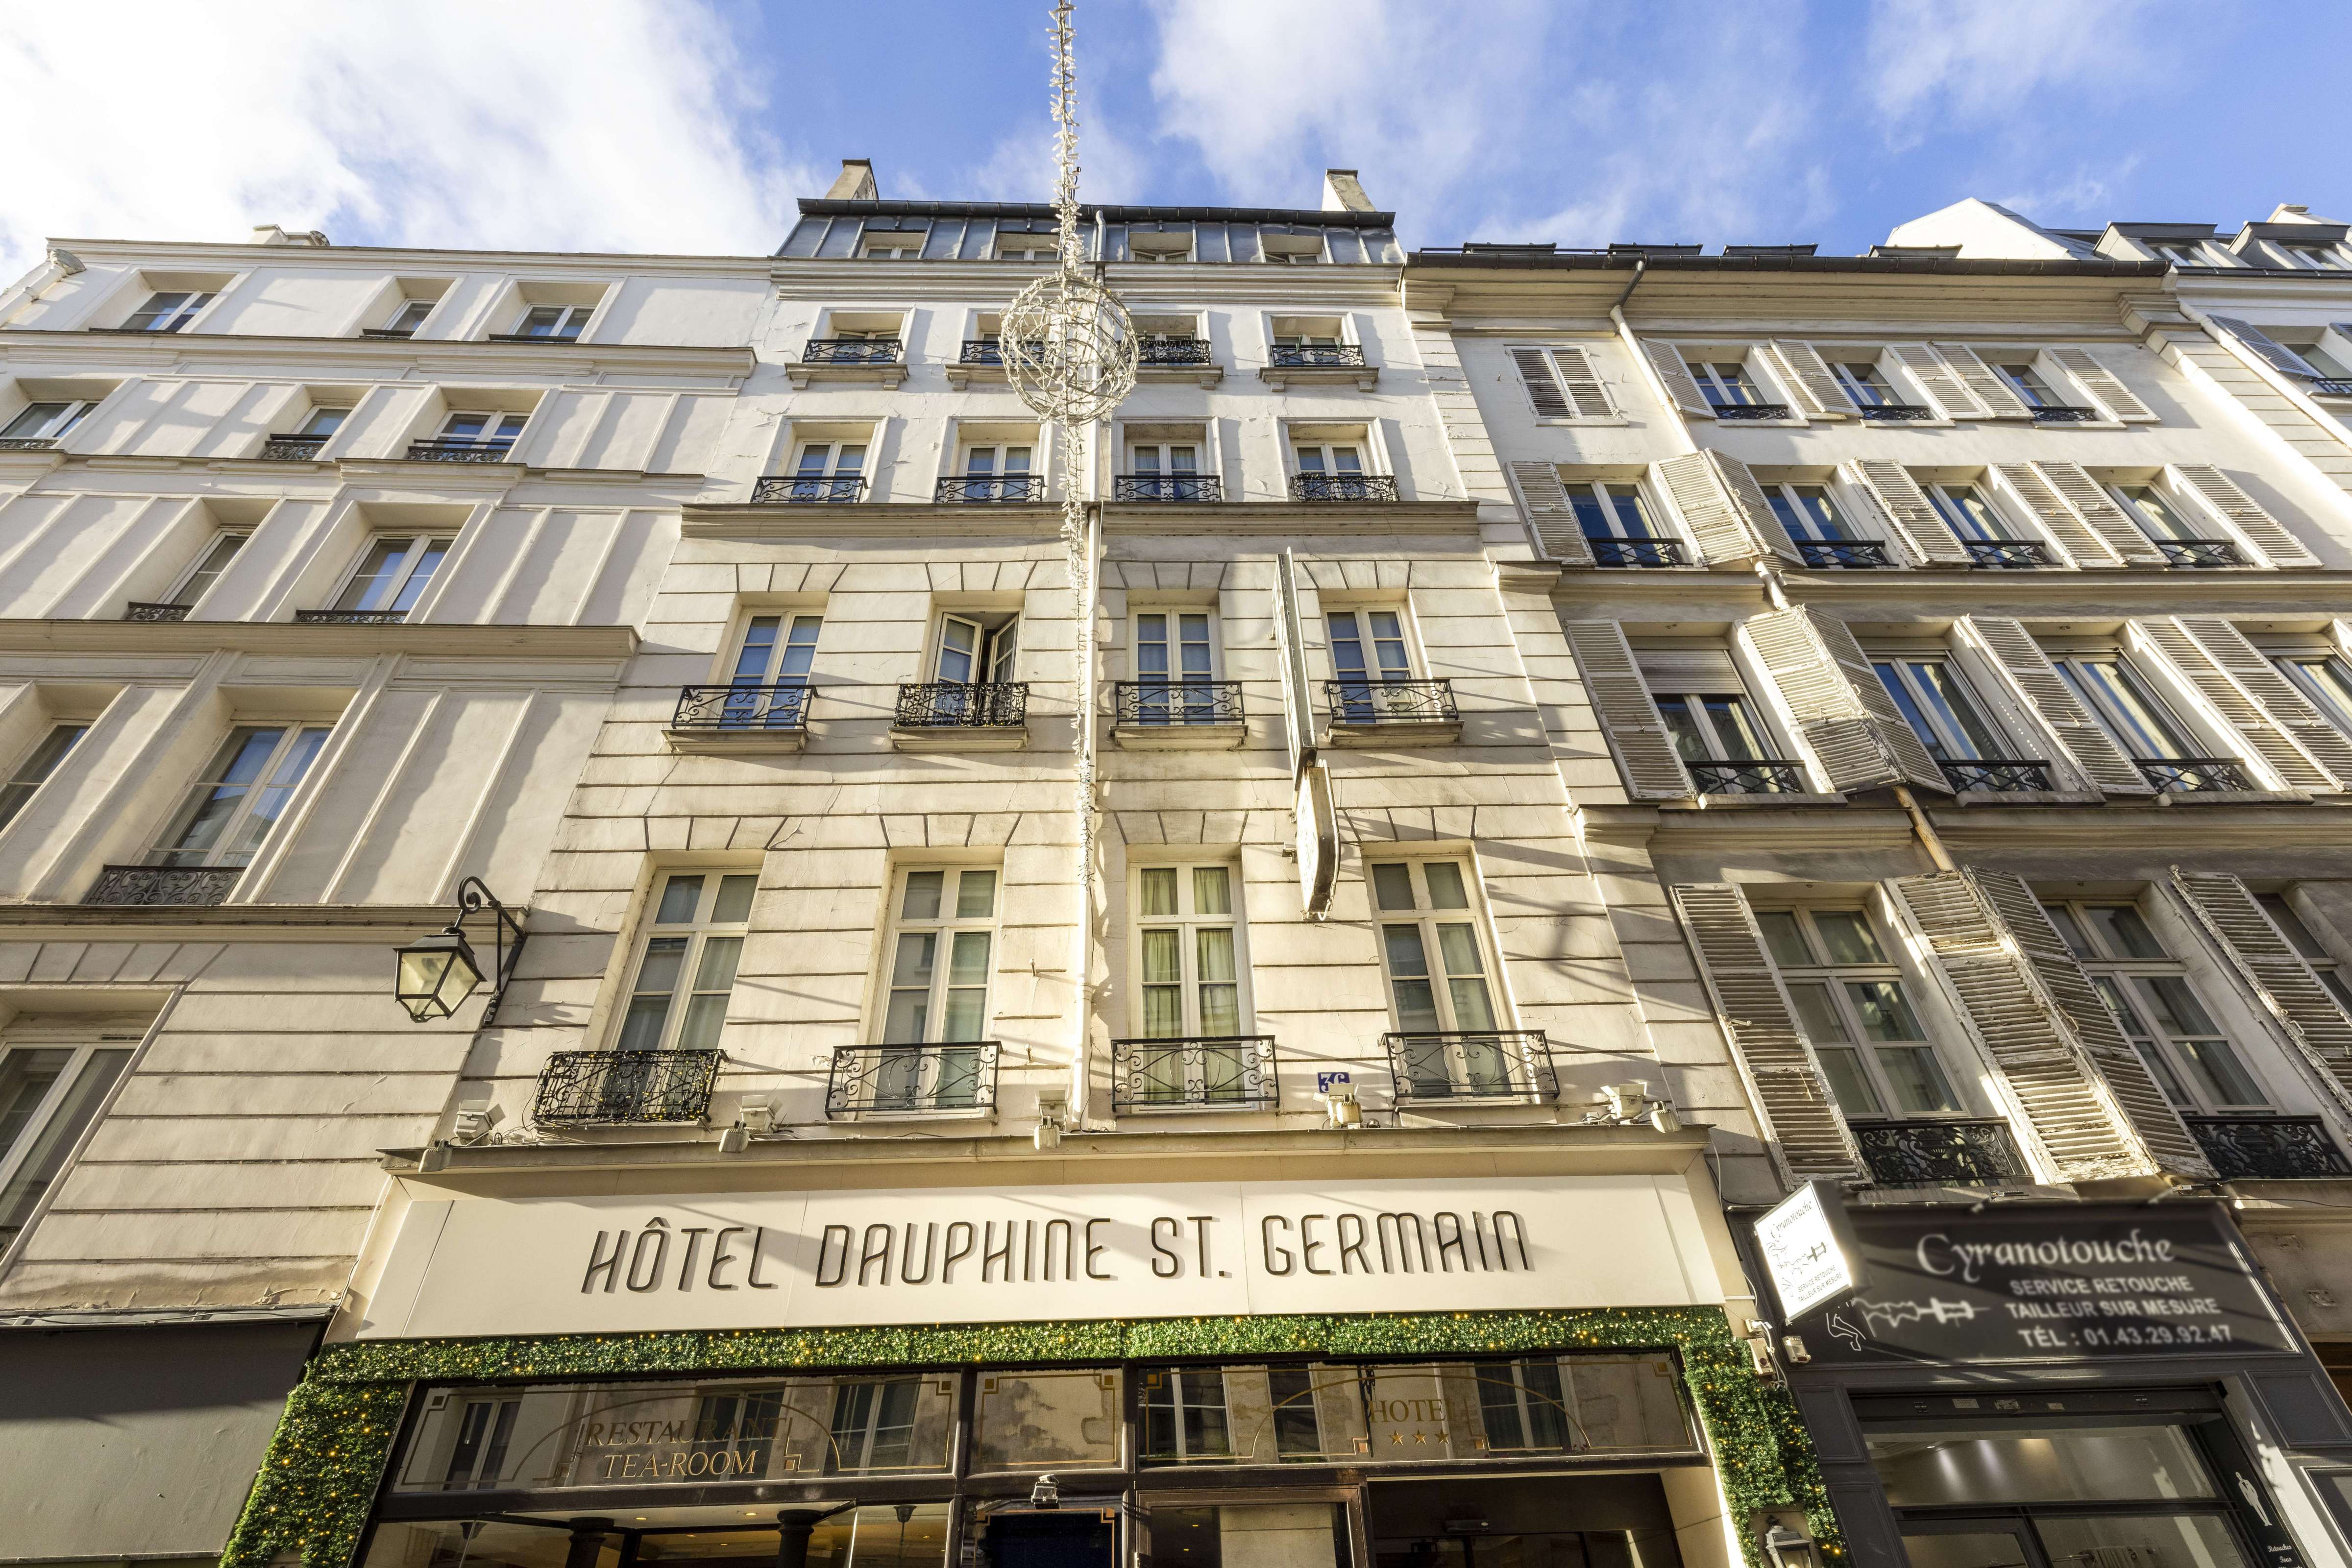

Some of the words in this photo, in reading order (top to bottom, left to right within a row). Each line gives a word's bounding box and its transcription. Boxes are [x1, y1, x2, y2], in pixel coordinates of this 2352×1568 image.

[1770, 1200, 1812, 1238] Cyranotouche
[581, 1217, 773, 1293] HÔTEL
[815, 1218, 1110, 1287] DAUPHINE
[1152, 1216, 1225, 1277] ST.
[1261, 1210, 1529, 1276] GERMAIN
[1916, 1229, 2175, 1283] Cyranotouche
[1798, 1279, 1814, 1292] SERVICE
[1814, 1265, 1837, 1282] RETOUCHE
[1798, 1286, 1817, 1302] TAILLEUR
[1817, 1282, 1825, 1292] SUR
[1826, 1272, 1843, 1287] MESURE
[2009, 1279, 2091, 1296] SERVICE
[2093, 1276, 2194, 1292] RETOUCHE
[2005, 1301, 2099, 1318] TAILLEUR
[2099, 1300, 2142, 1317] SUR
[2142, 1298, 2222, 1315] MESURE
[1369, 1399, 1466, 1423] HOTEL
[588, 1417, 786, 1446] RESTAURANT
[603, 1449, 759, 1478] TEA-ROOM
[2267, 1544, 2292, 1552] Retouches
